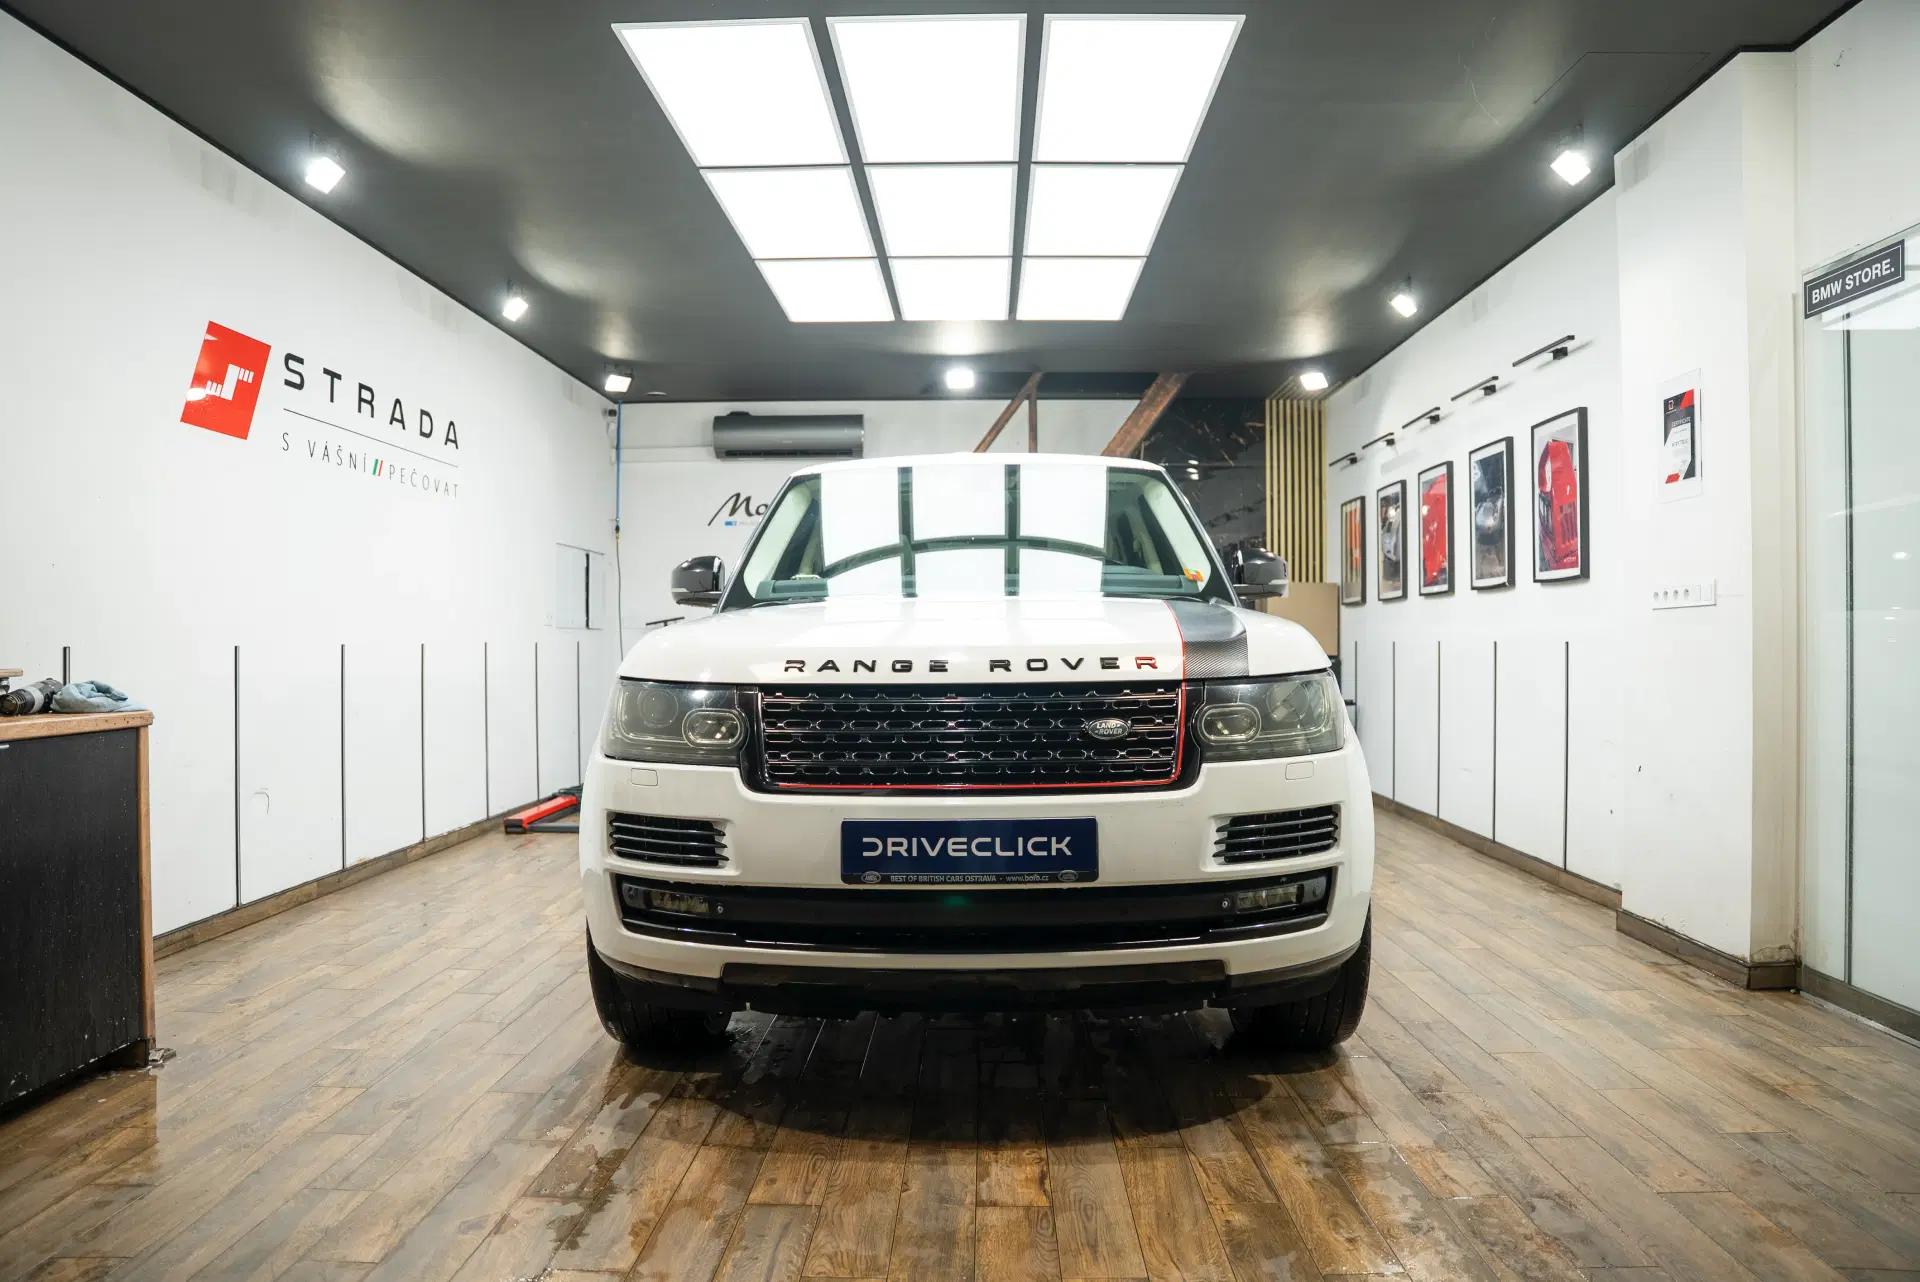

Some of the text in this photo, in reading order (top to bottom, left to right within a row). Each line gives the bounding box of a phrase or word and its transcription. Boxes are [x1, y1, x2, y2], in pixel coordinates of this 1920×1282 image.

[1812, 258, 1895, 304] BMW STORE.
[284, 353, 459, 449] STRADA
[282, 432, 459, 499] S VÁŠNÍ PEČOVAT
[784, 656, 1158, 673] RANGE ROVER
[862, 836, 1073, 857] DRIVECLICK
